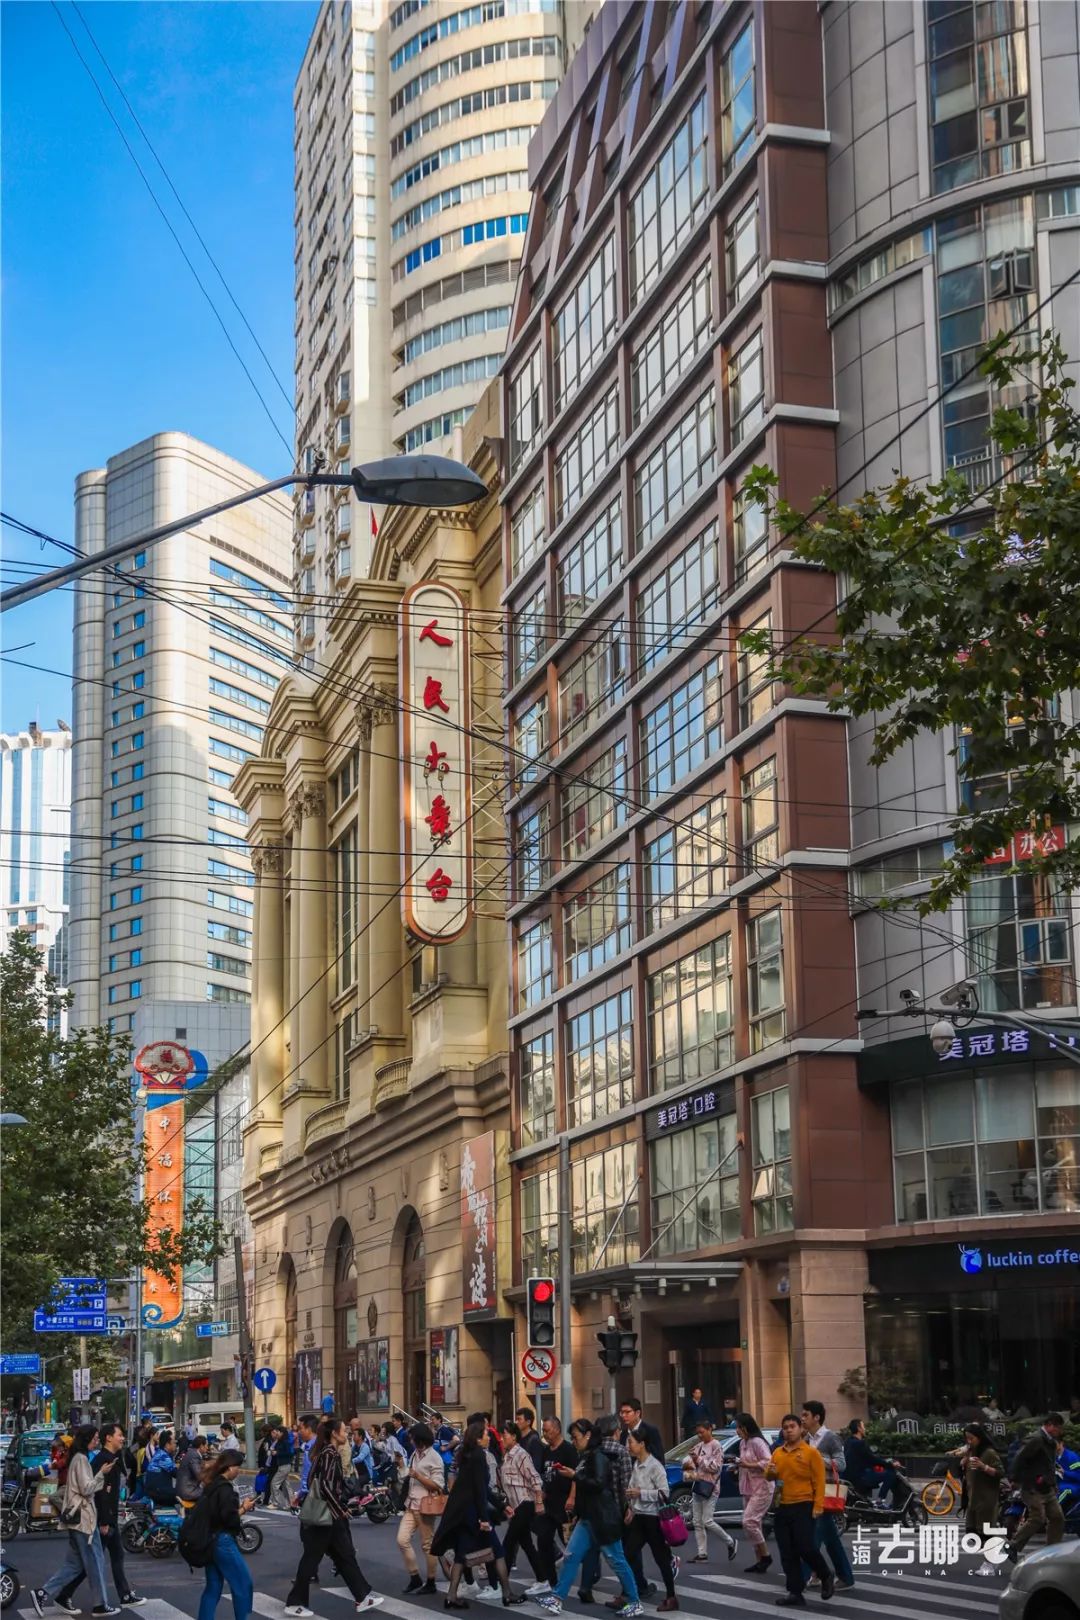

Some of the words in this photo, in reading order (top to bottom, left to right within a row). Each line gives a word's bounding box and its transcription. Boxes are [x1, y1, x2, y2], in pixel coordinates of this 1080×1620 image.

[418, 618, 454, 902] 人民大舞台
[987, 1251, 1033, 1268] luckin
[1037, 1248, 1080, 1265] coffe
